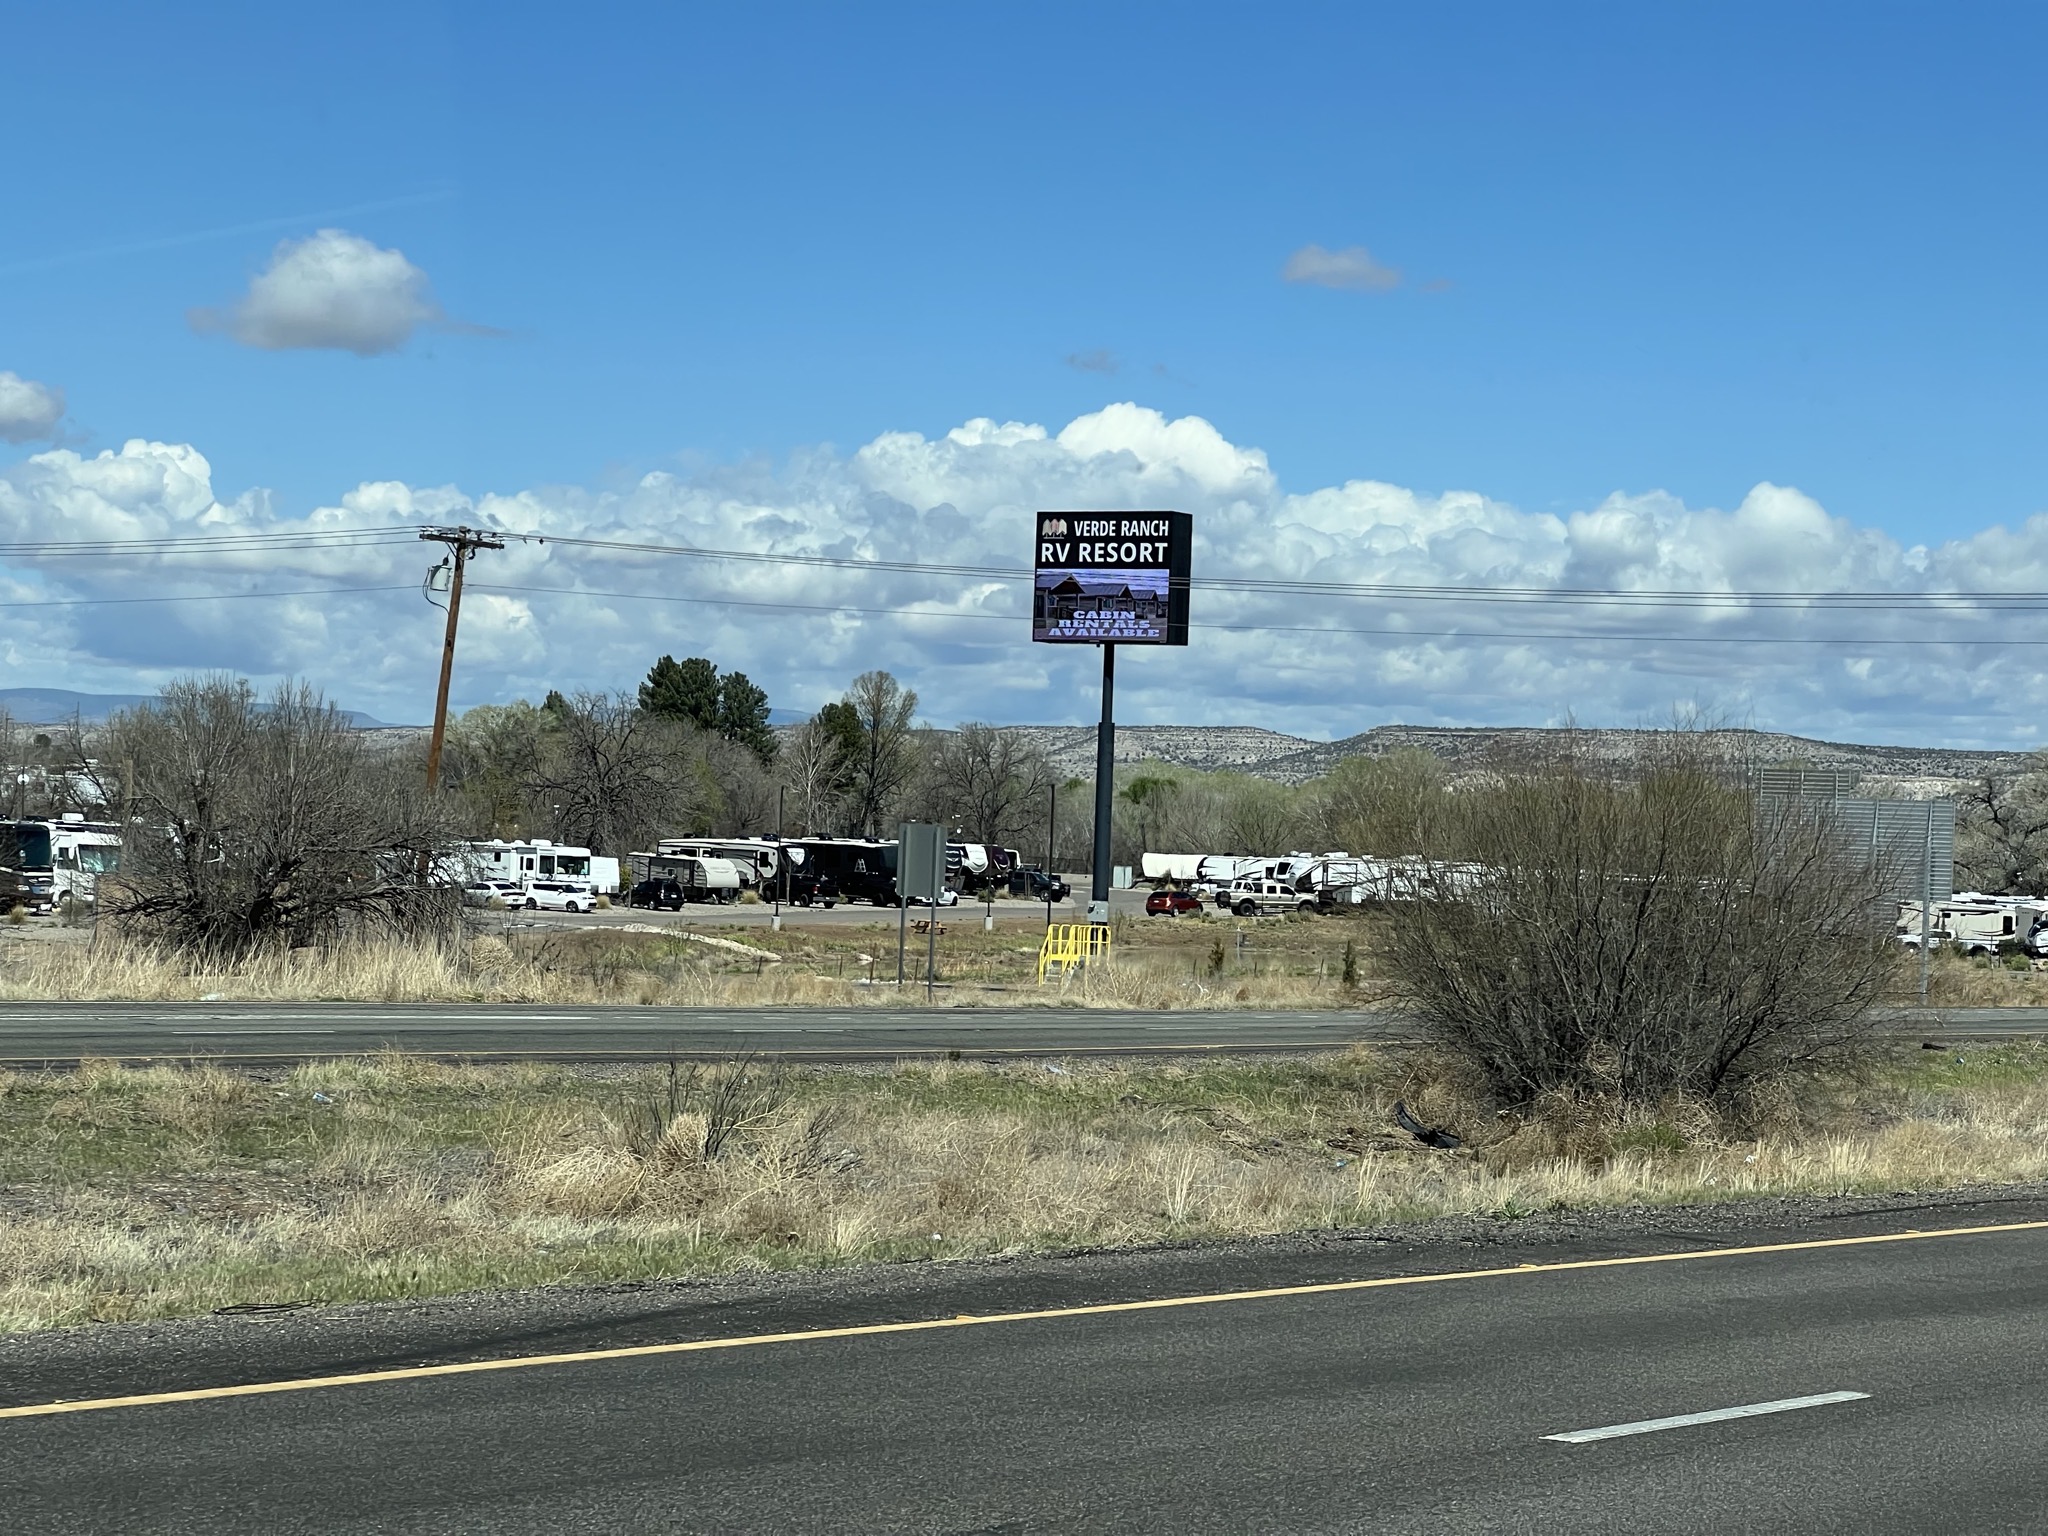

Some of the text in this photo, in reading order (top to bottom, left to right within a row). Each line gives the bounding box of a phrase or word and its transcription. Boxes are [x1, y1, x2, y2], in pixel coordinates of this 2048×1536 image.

[1074, 520, 1169, 537] VERDE RANCH
[1041, 542, 1168, 563] RV RESORT
[1073, 610, 1136, 620] CABIN
[1058, 619, 1151, 629] RENTALS
[1048, 627, 1160, 637] AVAILABLE
